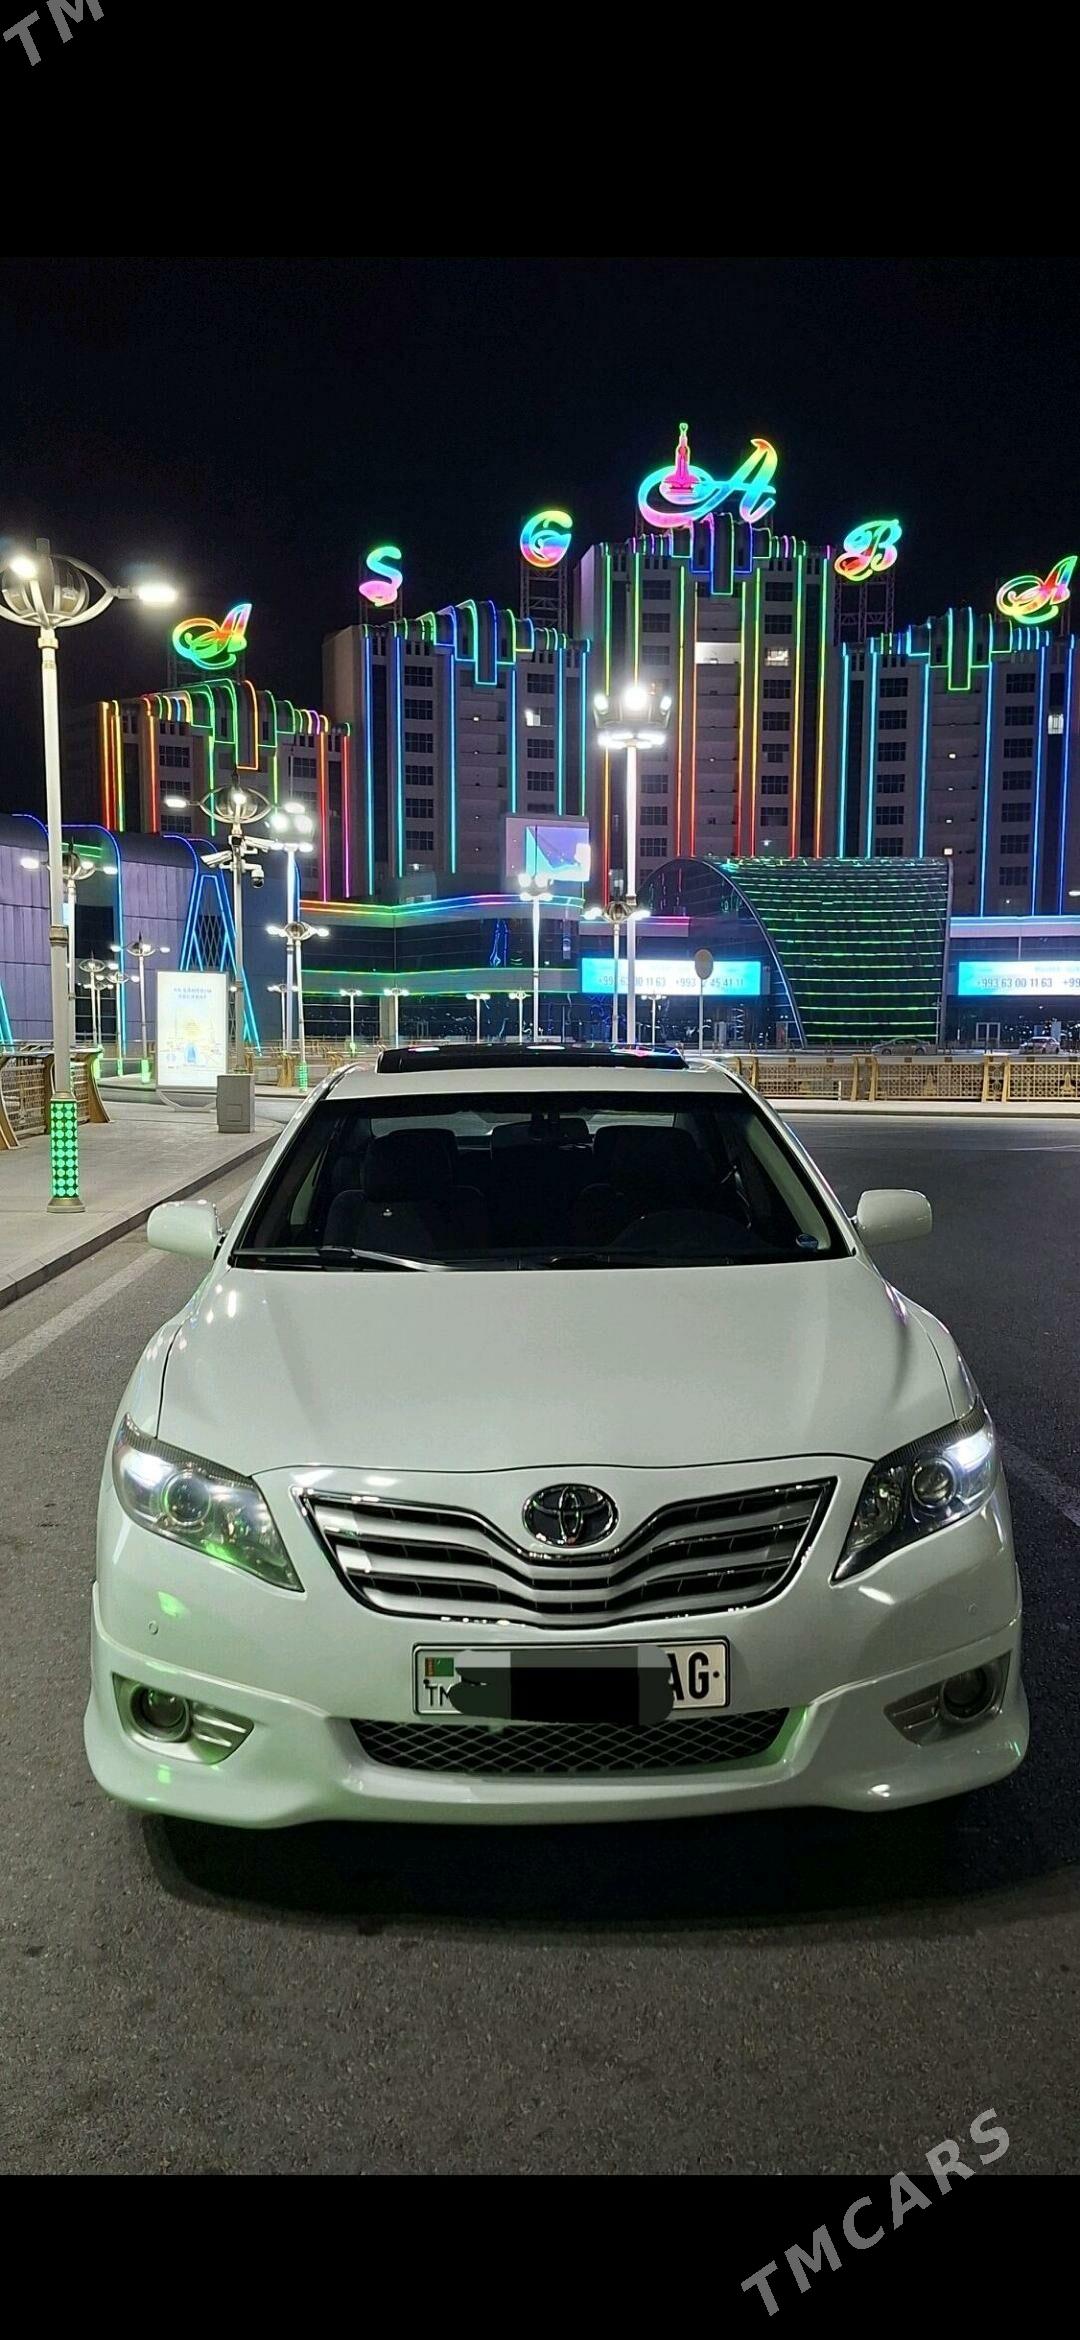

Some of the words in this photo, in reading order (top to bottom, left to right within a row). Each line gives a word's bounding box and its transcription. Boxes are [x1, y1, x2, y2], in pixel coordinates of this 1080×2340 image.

[977, 978, 998, 988] +993
[1001, 978, 1012, 988] 63
[1015, 978, 1027, 988] 00
[1030, 978, 1038, 988] 11
[1041, 978, 1053, 988] 63
